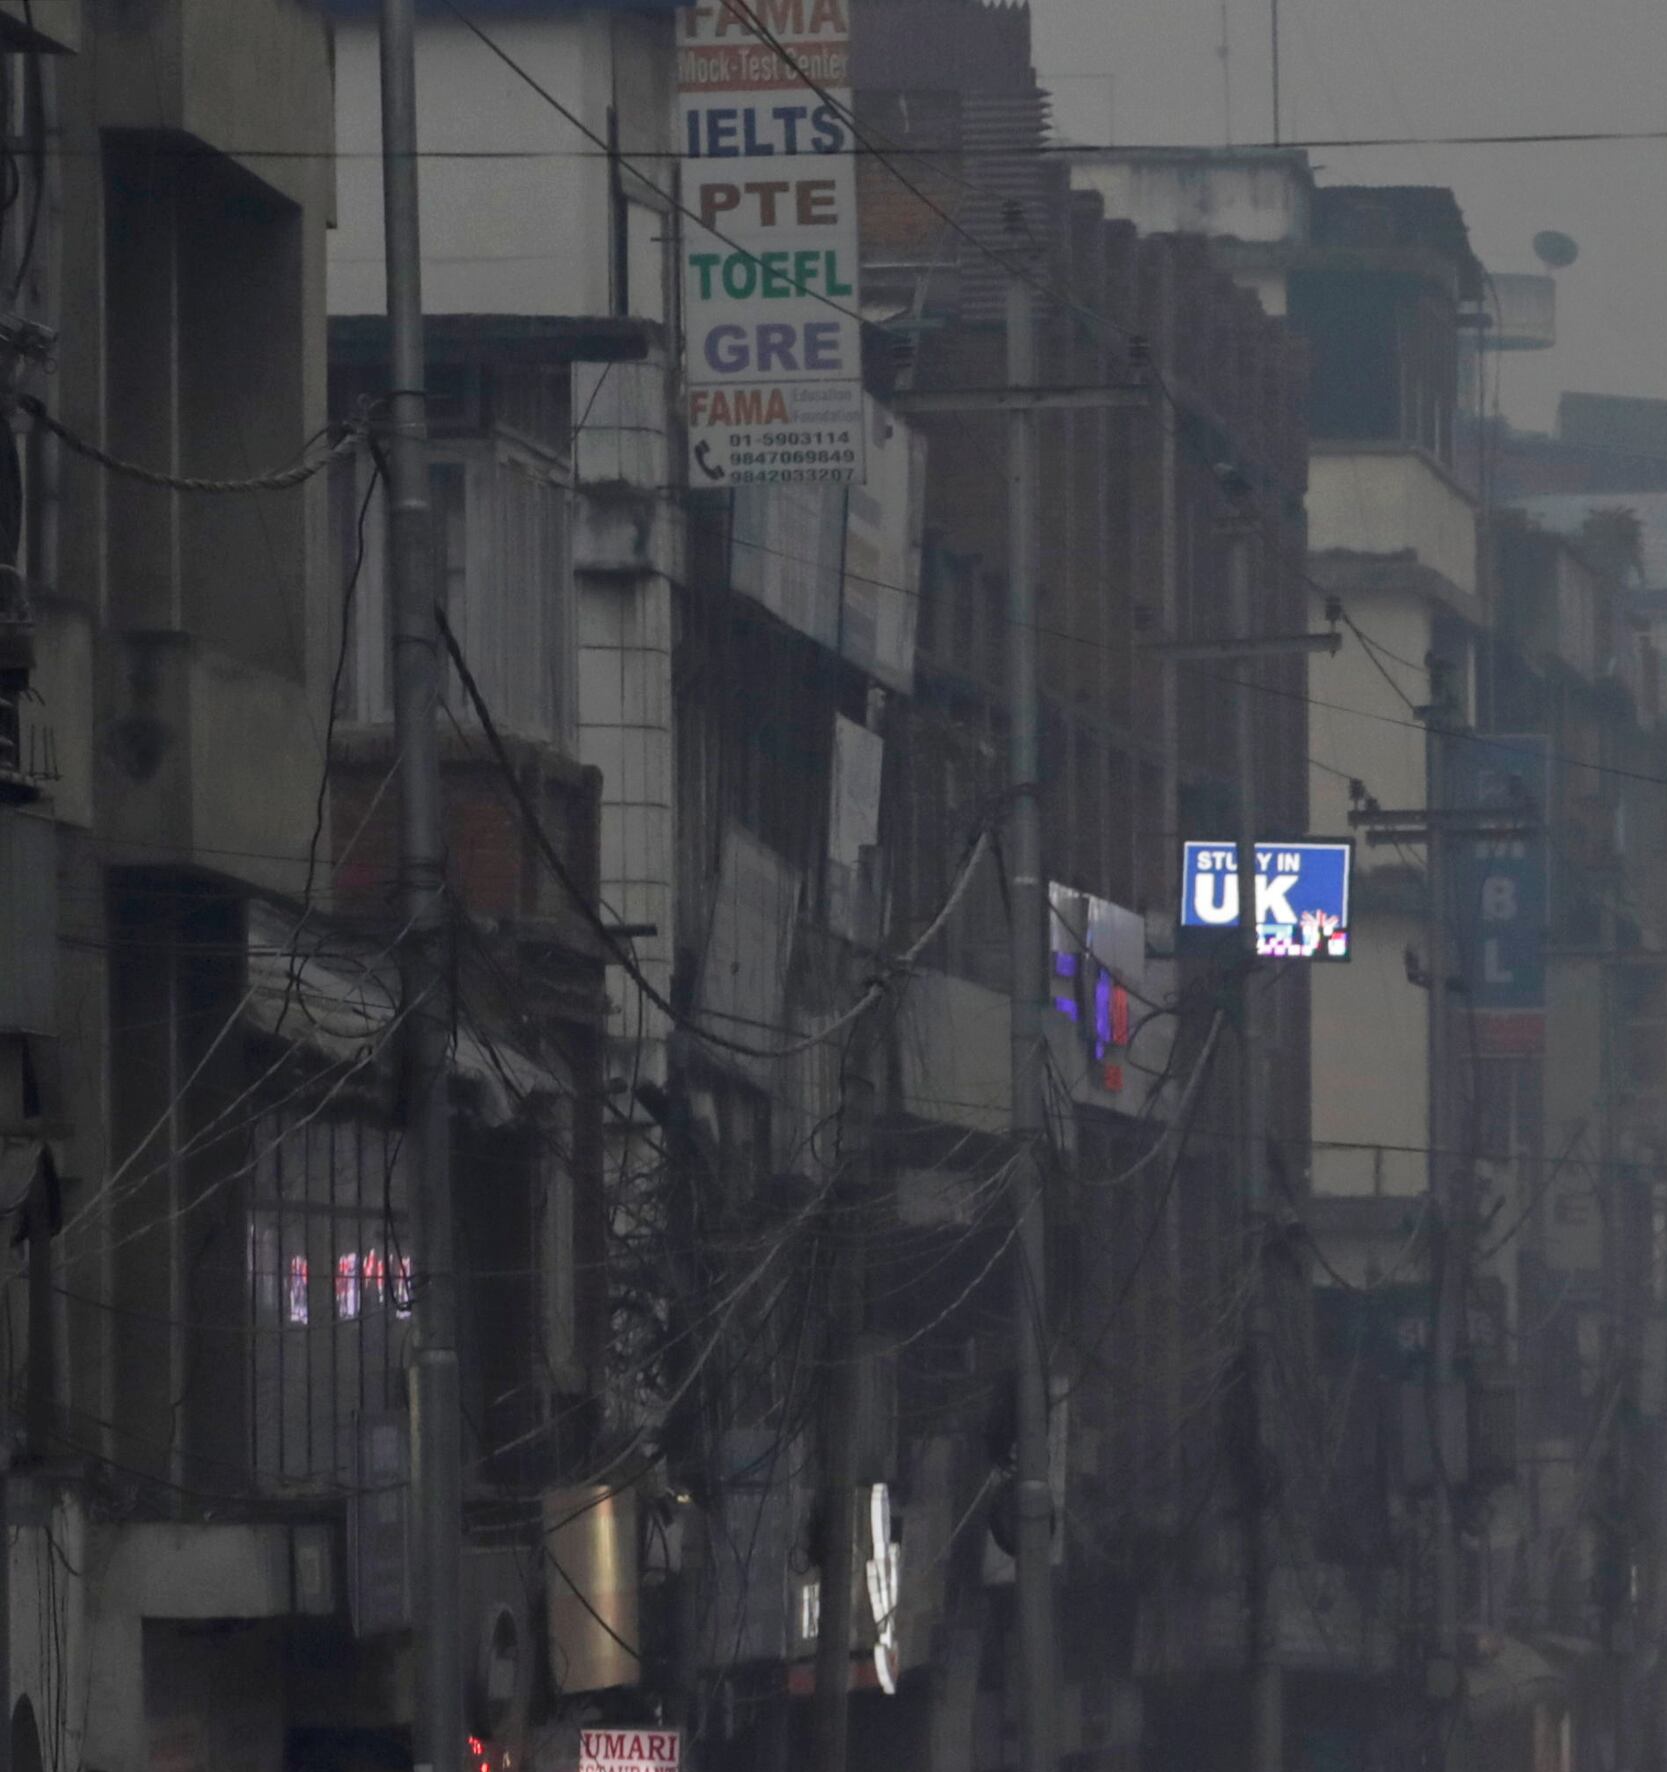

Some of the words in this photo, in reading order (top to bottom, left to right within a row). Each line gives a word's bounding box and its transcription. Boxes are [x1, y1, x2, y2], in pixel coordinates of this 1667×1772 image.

[686, 0, 848, 38] FAMA
[687, 104, 845, 158] IELTS
[700, 179, 838, 228] PTE
[688, 250, 853, 300] TOEFL
[703, 321, 845, 374] GRE
[688, 388, 790, 427] FAMA
[729, 431, 850, 447] 01-5903114
[729, 449, 855, 465] 9847069849
[1196, 851, 1272, 872] STUY
[1277, 852, 1301, 872] IN
[1193, 872, 1299, 925] UK
[583, 1732, 678, 1762] UMARI
